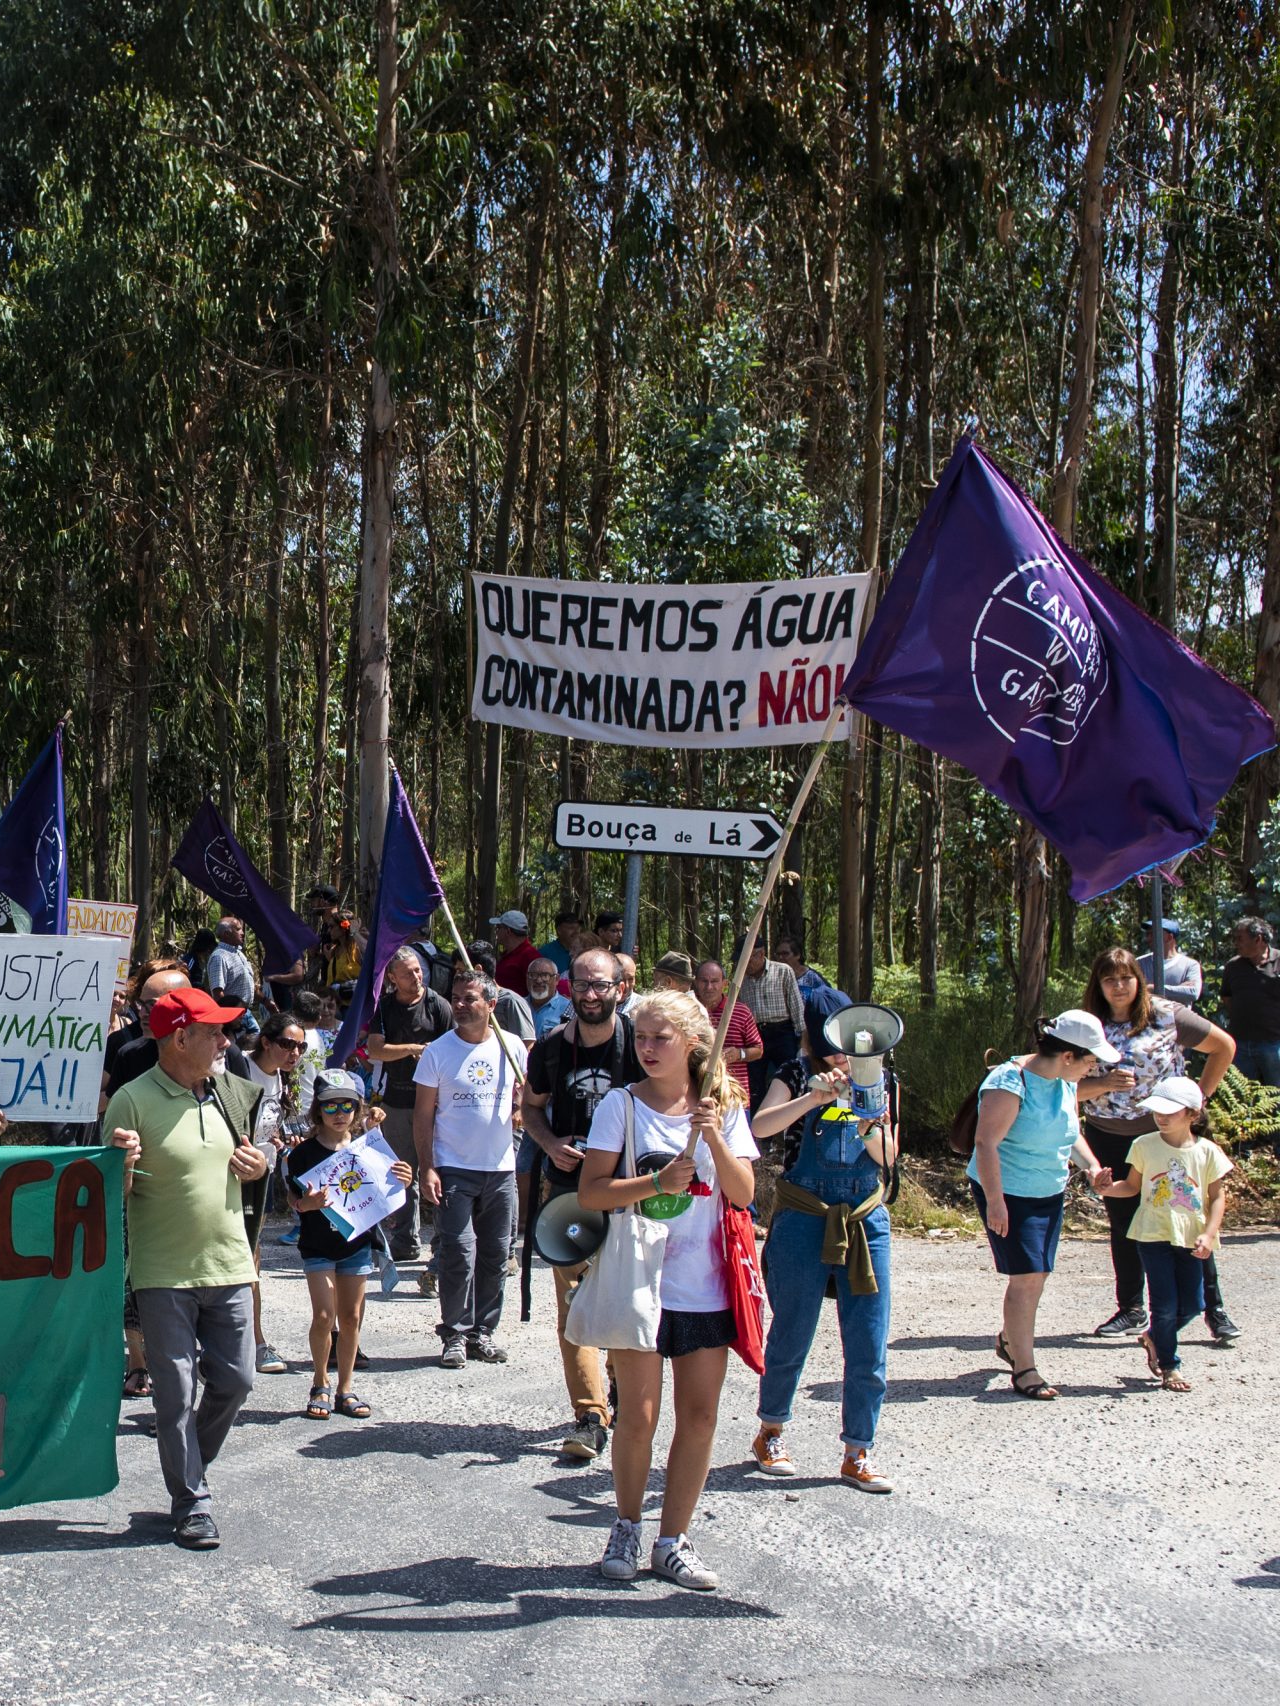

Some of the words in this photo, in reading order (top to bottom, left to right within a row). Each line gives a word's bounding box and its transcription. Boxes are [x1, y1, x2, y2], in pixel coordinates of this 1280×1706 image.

[481, 580, 723, 653] QUEREMOS
[731, 585, 856, 651] ÁGUA
[1026, 580, 1089, 643] CAMP
[481, 654, 747, 733] CONTAMINADA?
[757, 657, 846, 728] NÃO!
[566, 813, 657, 847] Bouça
[674, 830, 693, 843] de
[708, 822, 741, 846] Lá
